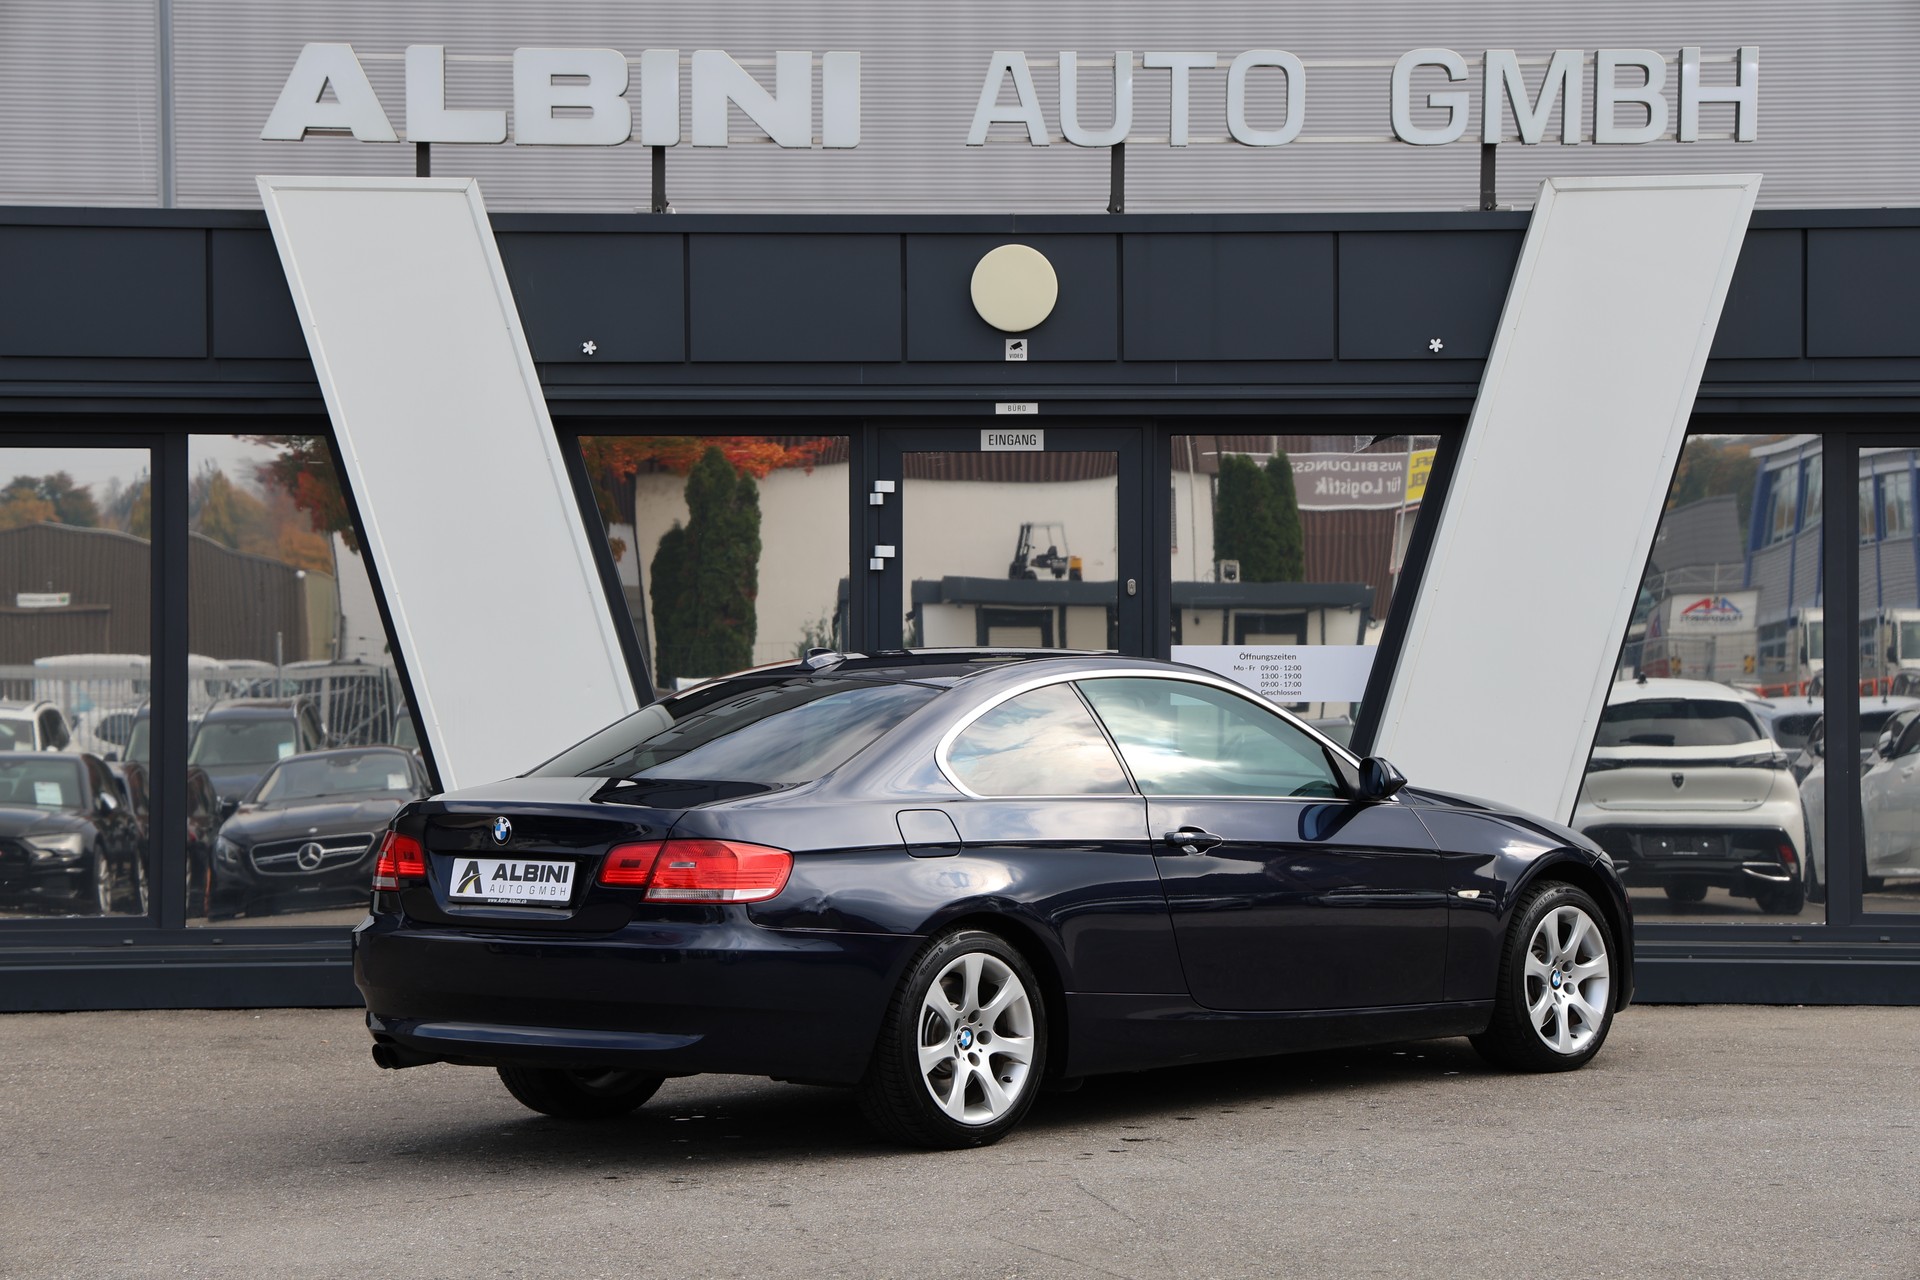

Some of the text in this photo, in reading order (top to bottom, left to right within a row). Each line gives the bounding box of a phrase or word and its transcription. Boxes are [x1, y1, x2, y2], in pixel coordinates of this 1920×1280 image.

[260, 42, 1760, 149] ALBINI AUTO GMBH
[1007, 403, 1026, 412] BÜRO
[988, 434, 1037, 446] EINGANG
[1239, 652, 1297, 661] Öffnungszeiten
[491, 863, 570, 883] ALBINI
[489, 884, 567, 896] AUTO GMBH
